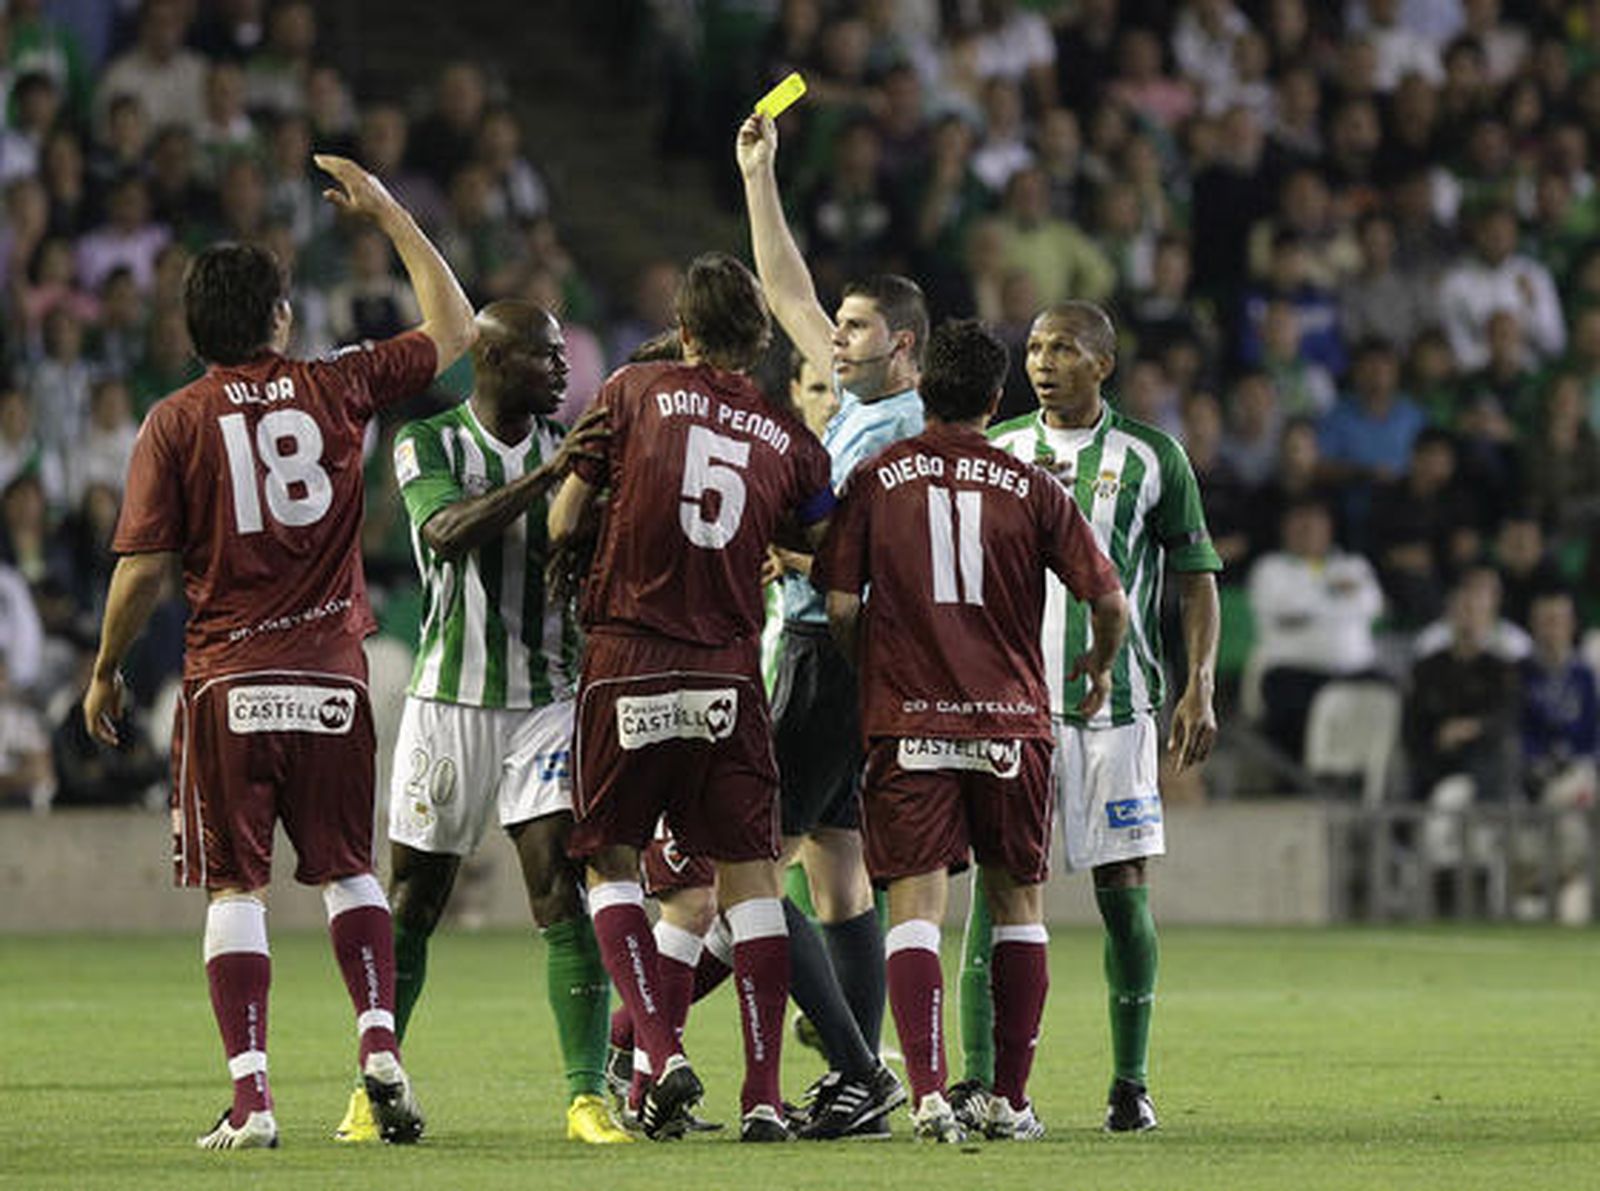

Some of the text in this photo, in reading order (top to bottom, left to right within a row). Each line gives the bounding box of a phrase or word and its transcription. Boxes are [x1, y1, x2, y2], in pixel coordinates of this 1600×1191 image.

[217, 408, 334, 535] 18
[679, 424, 751, 549] 5
[877, 453, 1030, 499] DIEGO REYES
[927, 484, 985, 606] 11
